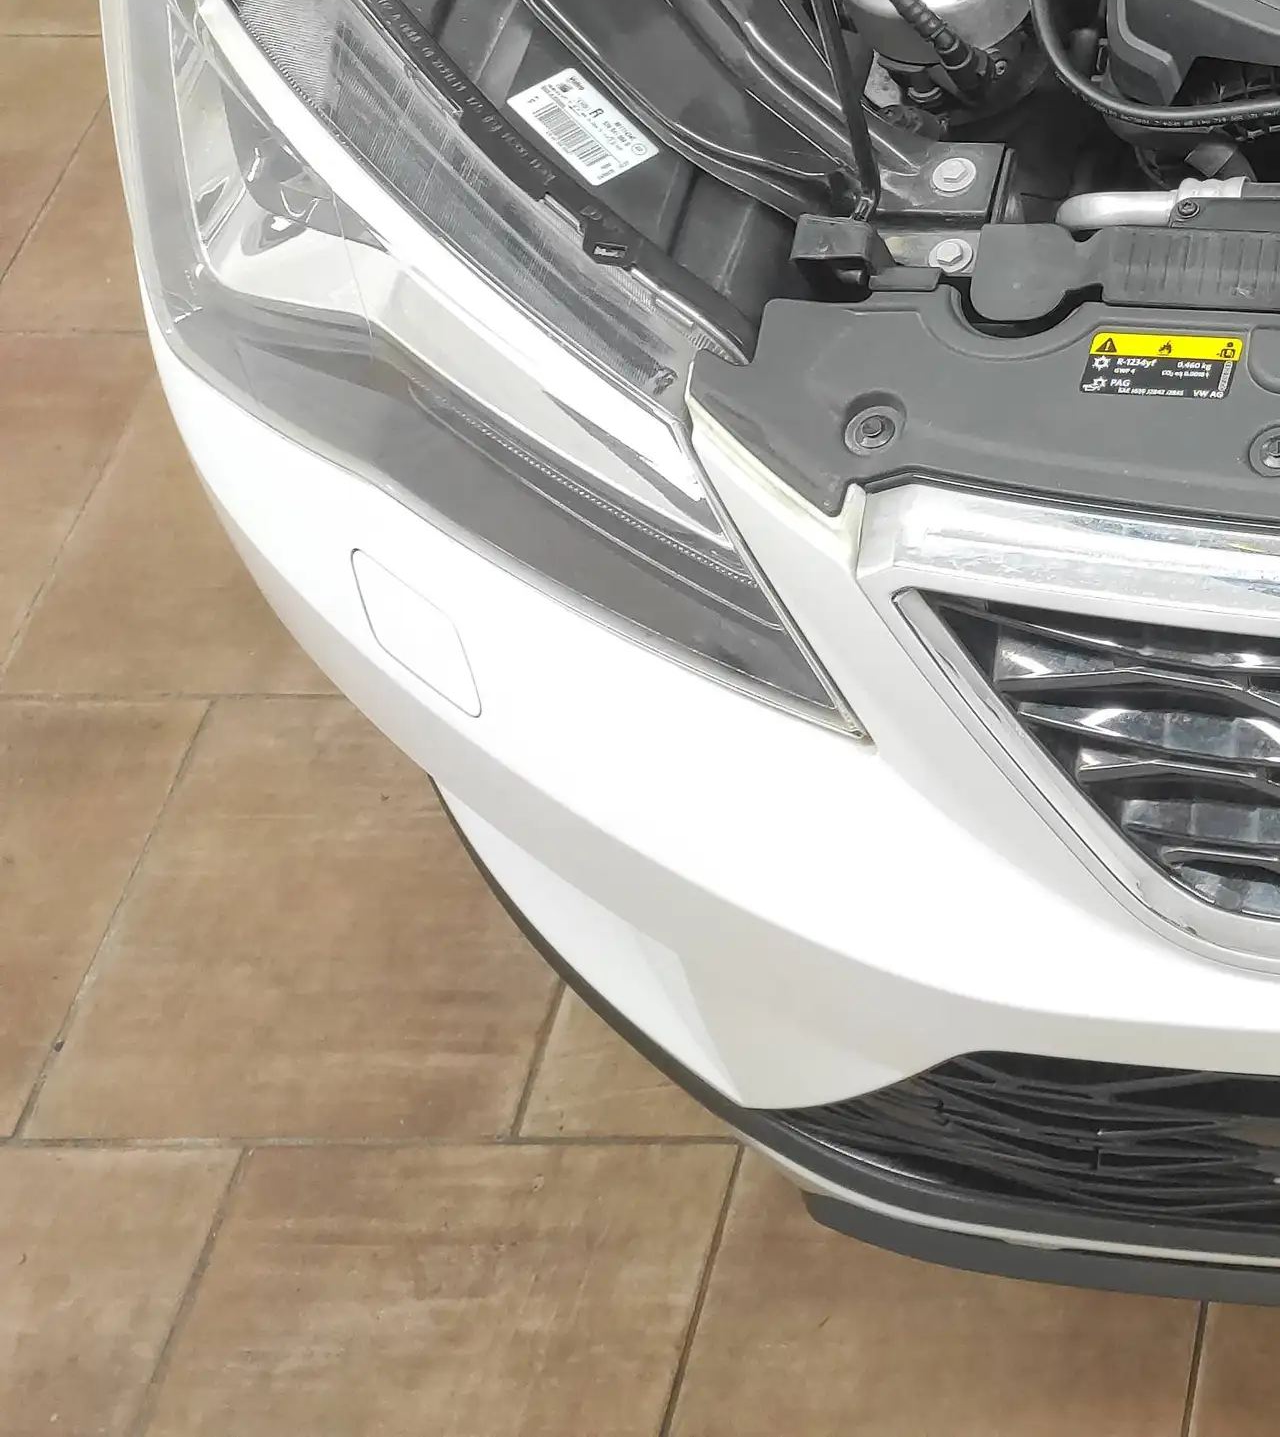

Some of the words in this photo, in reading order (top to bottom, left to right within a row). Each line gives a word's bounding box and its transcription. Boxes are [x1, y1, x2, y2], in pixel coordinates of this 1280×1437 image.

[588, 108, 604, 118] R
[1116, 357, 1158, 368] R-1234yf
[1201, 362, 1213, 371] kg
[1110, 378, 1131, 387] PAG
[1193, 389, 1208, 398] VW
[1209, 390, 1225, 399] AG
